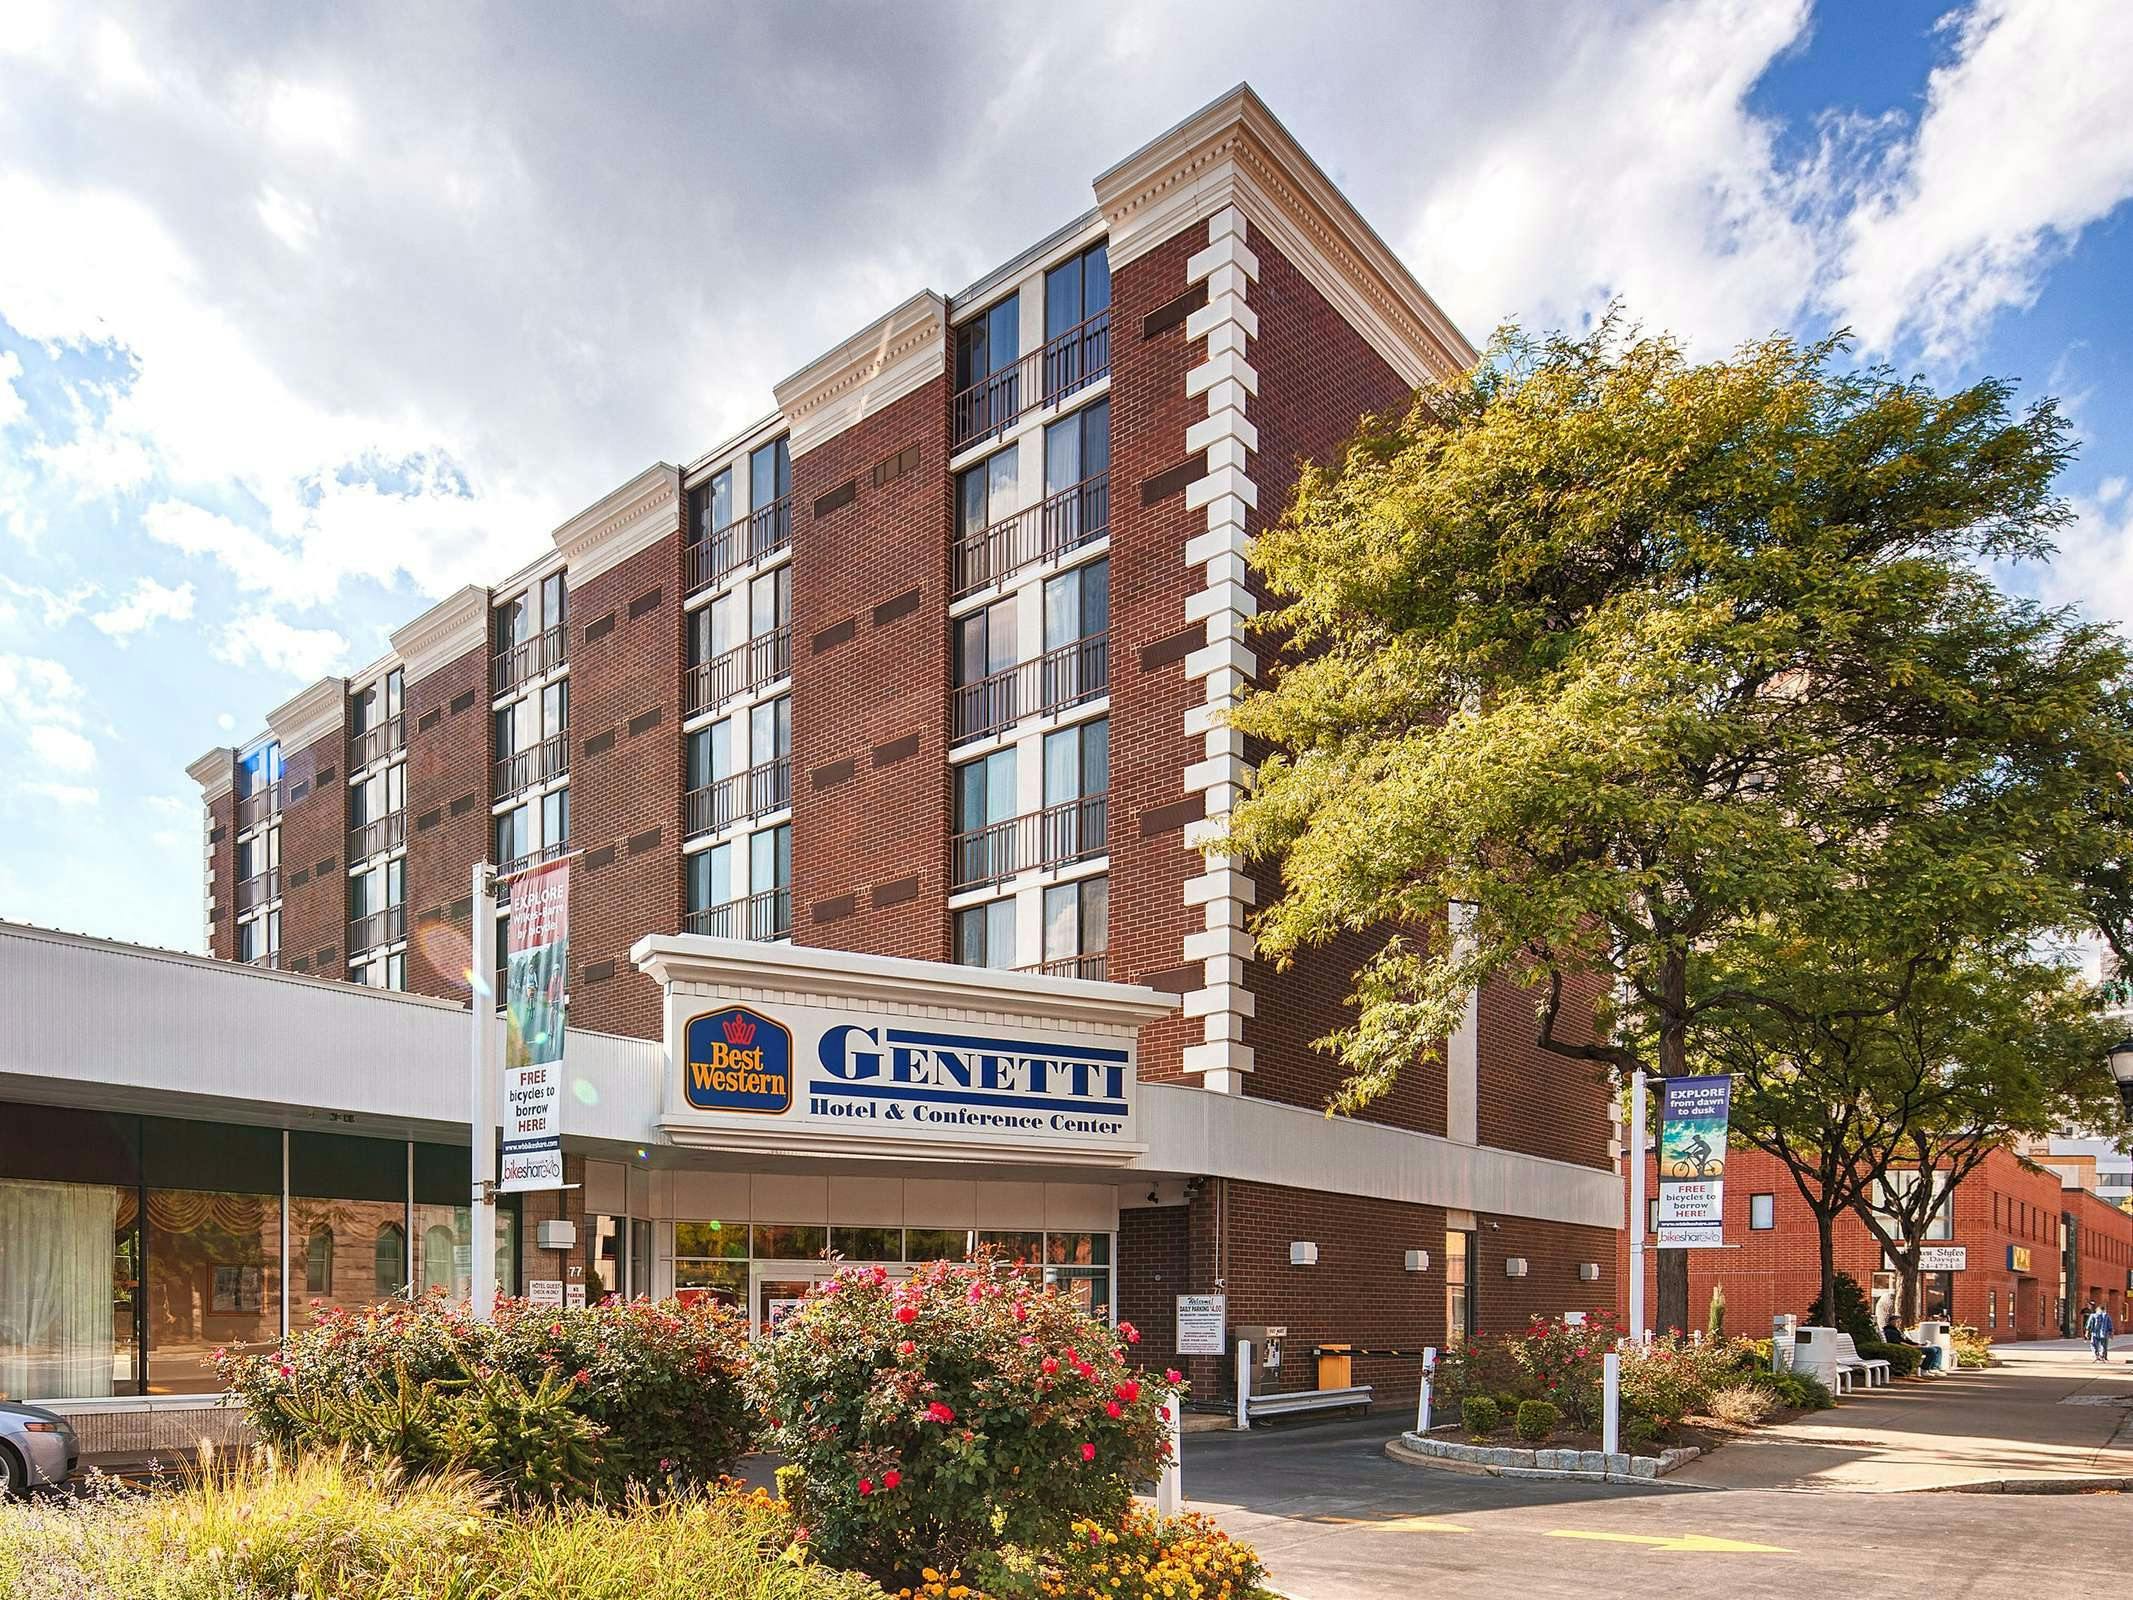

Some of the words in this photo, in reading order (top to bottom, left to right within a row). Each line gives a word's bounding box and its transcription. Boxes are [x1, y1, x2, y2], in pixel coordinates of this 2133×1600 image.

[514, 884, 564, 911] EXPLORE
[517, 928, 527, 942] by
[711, 1041, 764, 1071] Best
[818, 1024, 1127, 1099] GENETTI
[520, 1069, 547, 1086] FREE
[690, 1062, 786, 1095] Western
[509, 1087, 544, 1104] bicycles
[546, 1086, 555, 1097] to
[1670, 1088, 1725, 1099] EXPLORE
[1670, 1100, 1695, 1108] from
[1697, 1098, 1724, 1106] dawn
[515, 1104, 549, 1117] borrow
[810, 1098, 876, 1118] Hotel
[884, 1103, 905, 1120] &
[913, 1104, 1043, 1129] Conference
[1050, 1114, 1122, 1134] Center
[1691, 1106, 1716, 1115] dusk
[518, 1117, 546, 1133] HERE!
[1678, 1184, 1706, 1193] FREE
[1666, 1193, 1703, 1202] bicycles
[1673, 1202, 1709, 1210] borrow
[1936, 1248, 1964, 1257] Styles
[569, 1266, 582, 1277] 77
